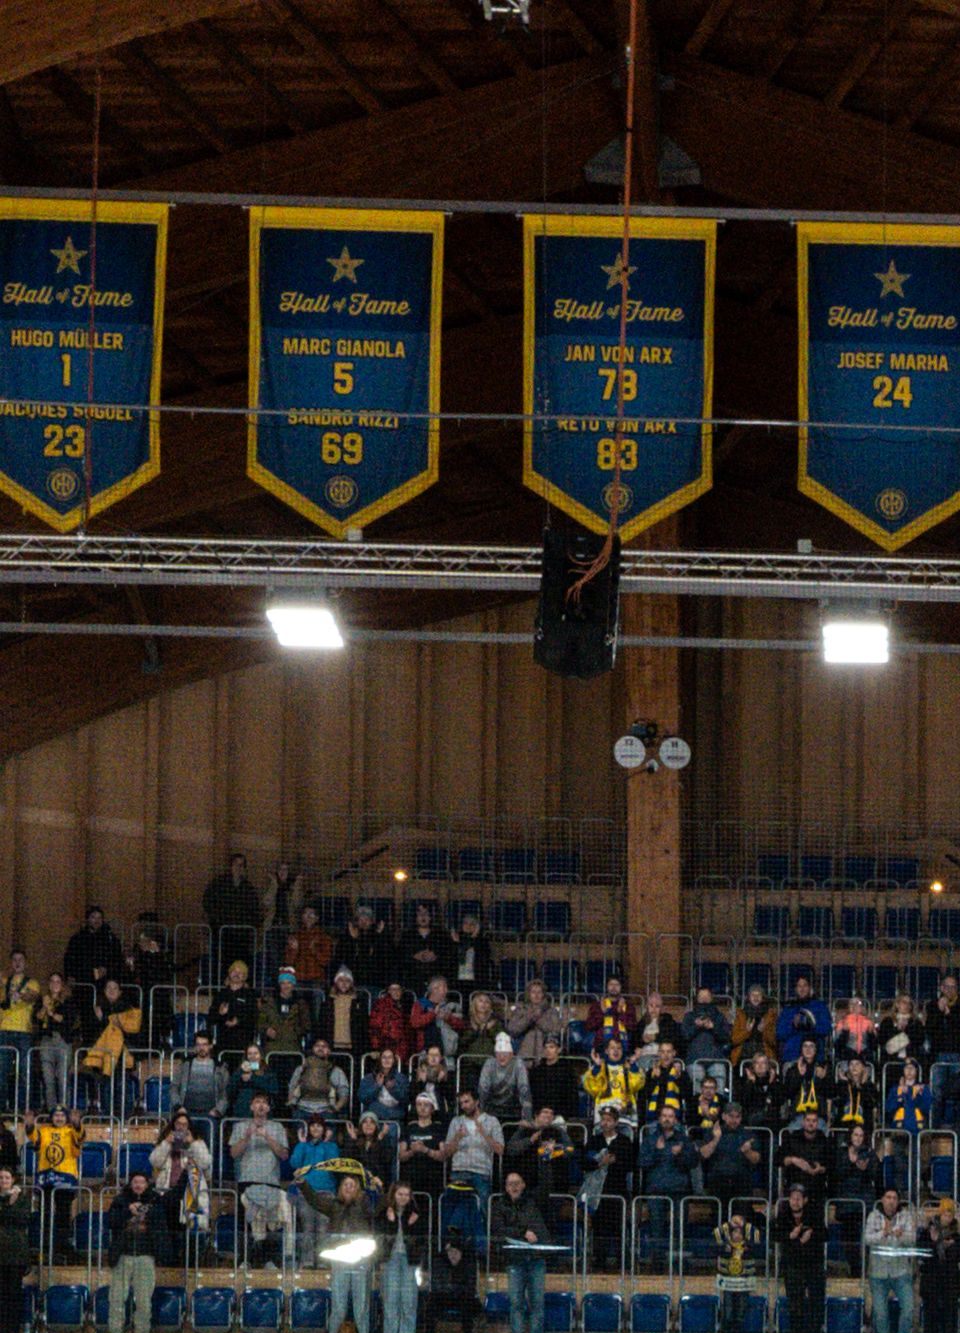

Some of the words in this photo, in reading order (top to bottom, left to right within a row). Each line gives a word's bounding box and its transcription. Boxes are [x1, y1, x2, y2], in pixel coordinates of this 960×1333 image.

[4, 281, 53, 306] Hall
[72, 284, 134, 307] Fame
[279, 291, 330, 315] Hall
[350, 293, 410, 316] Fame
[622, 300, 684, 321] Fame
[828, 306, 878, 329] Hall
[896, 307, 957, 330] Fame
[11, 329, 54, 348] HUGO
[59, 328, 124, 350] MÜLLER
[283, 338, 330, 355] MARC
[336, 339, 406, 358] GIANOLA
[565, 345, 595, 362] JAN
[601, 346, 634, 363] VON
[639, 348, 673, 365] ARX
[837, 352, 884, 369] JOSEF
[890, 353, 949, 372] MARHA
[62, 353, 71, 386] 1
[333, 362, 354, 394] 5
[873, 376, 912, 408] 24
[44, 424, 85, 458] 23
[322, 432, 363, 465] 69
[597, 438, 638, 470] 83
